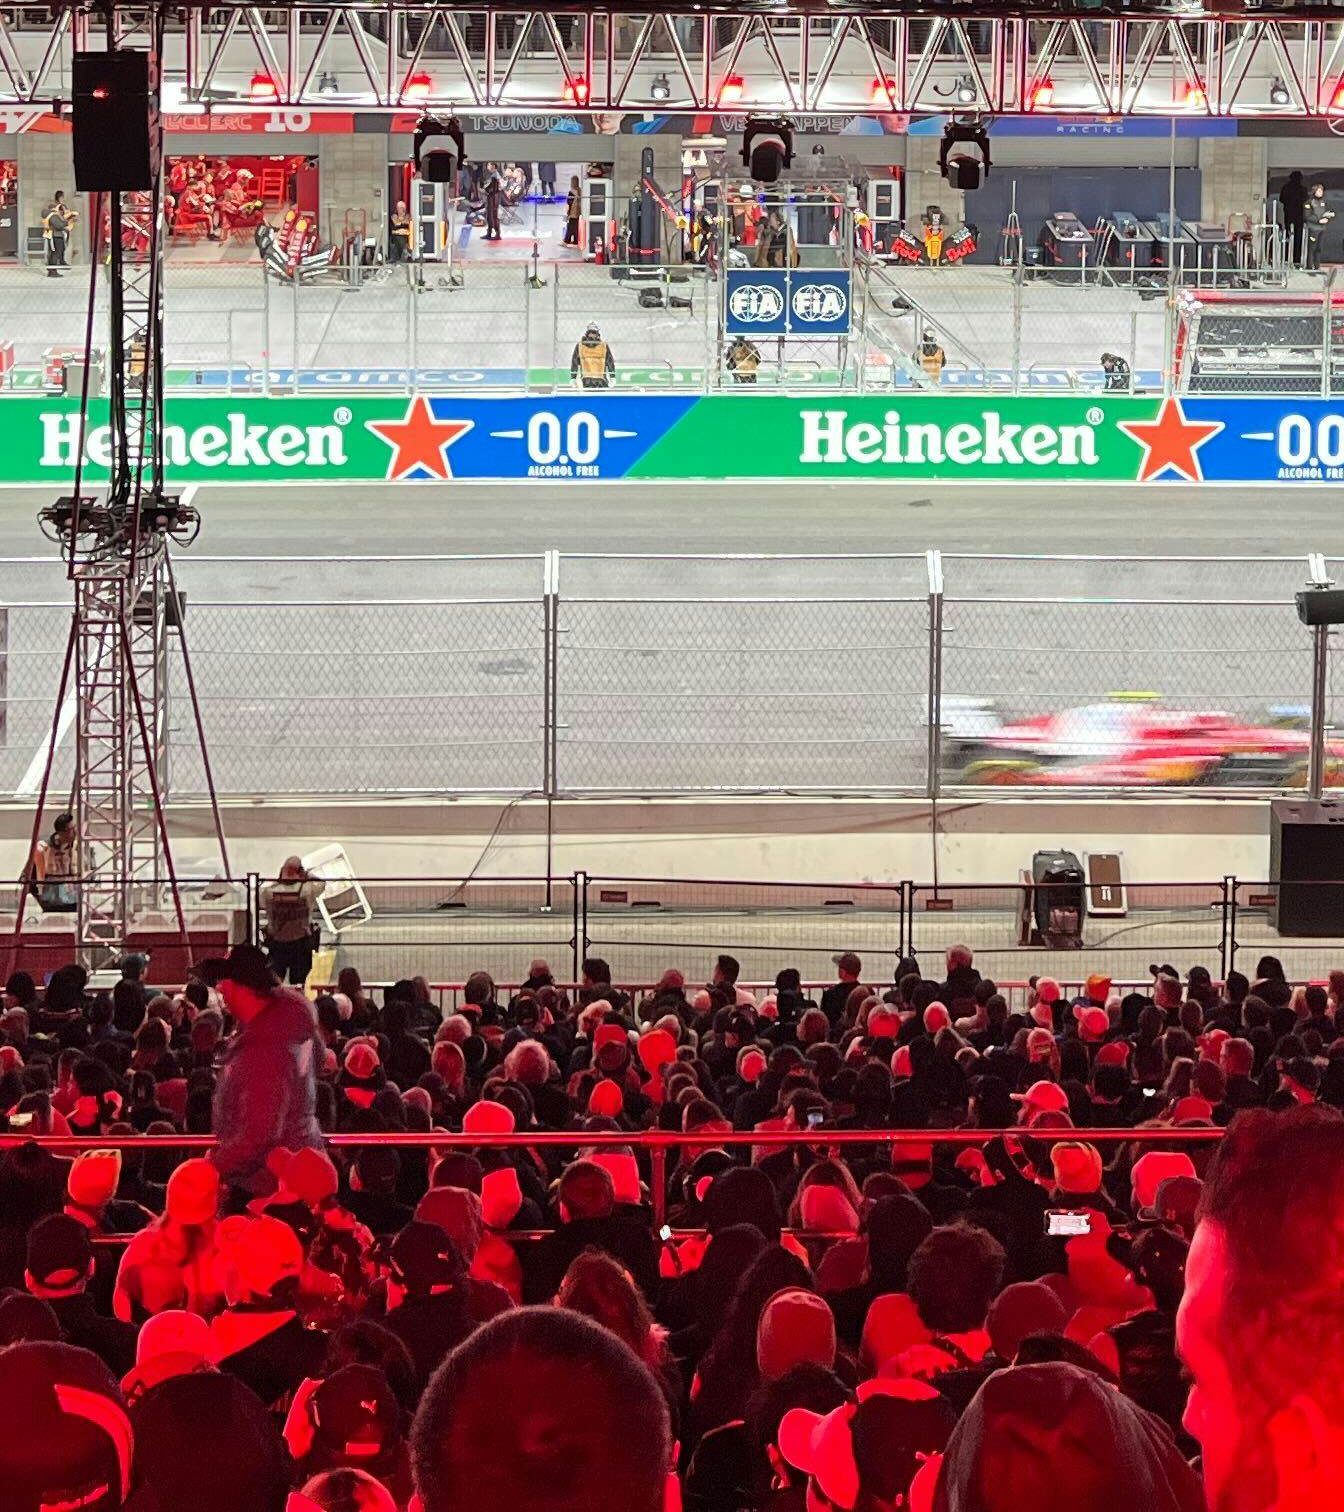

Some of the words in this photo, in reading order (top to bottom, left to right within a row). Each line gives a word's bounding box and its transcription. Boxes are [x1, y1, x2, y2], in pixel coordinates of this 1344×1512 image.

[469, 115, 578, 131] TSUNODA
[1056, 126, 1124, 134] RACING
[528, 412, 600, 464] 0.0
[527, 465, 573, 477] ALCOHOL
[576, 465, 600, 477] FREE
[1277, 467, 1323, 479] ALCOHOL
